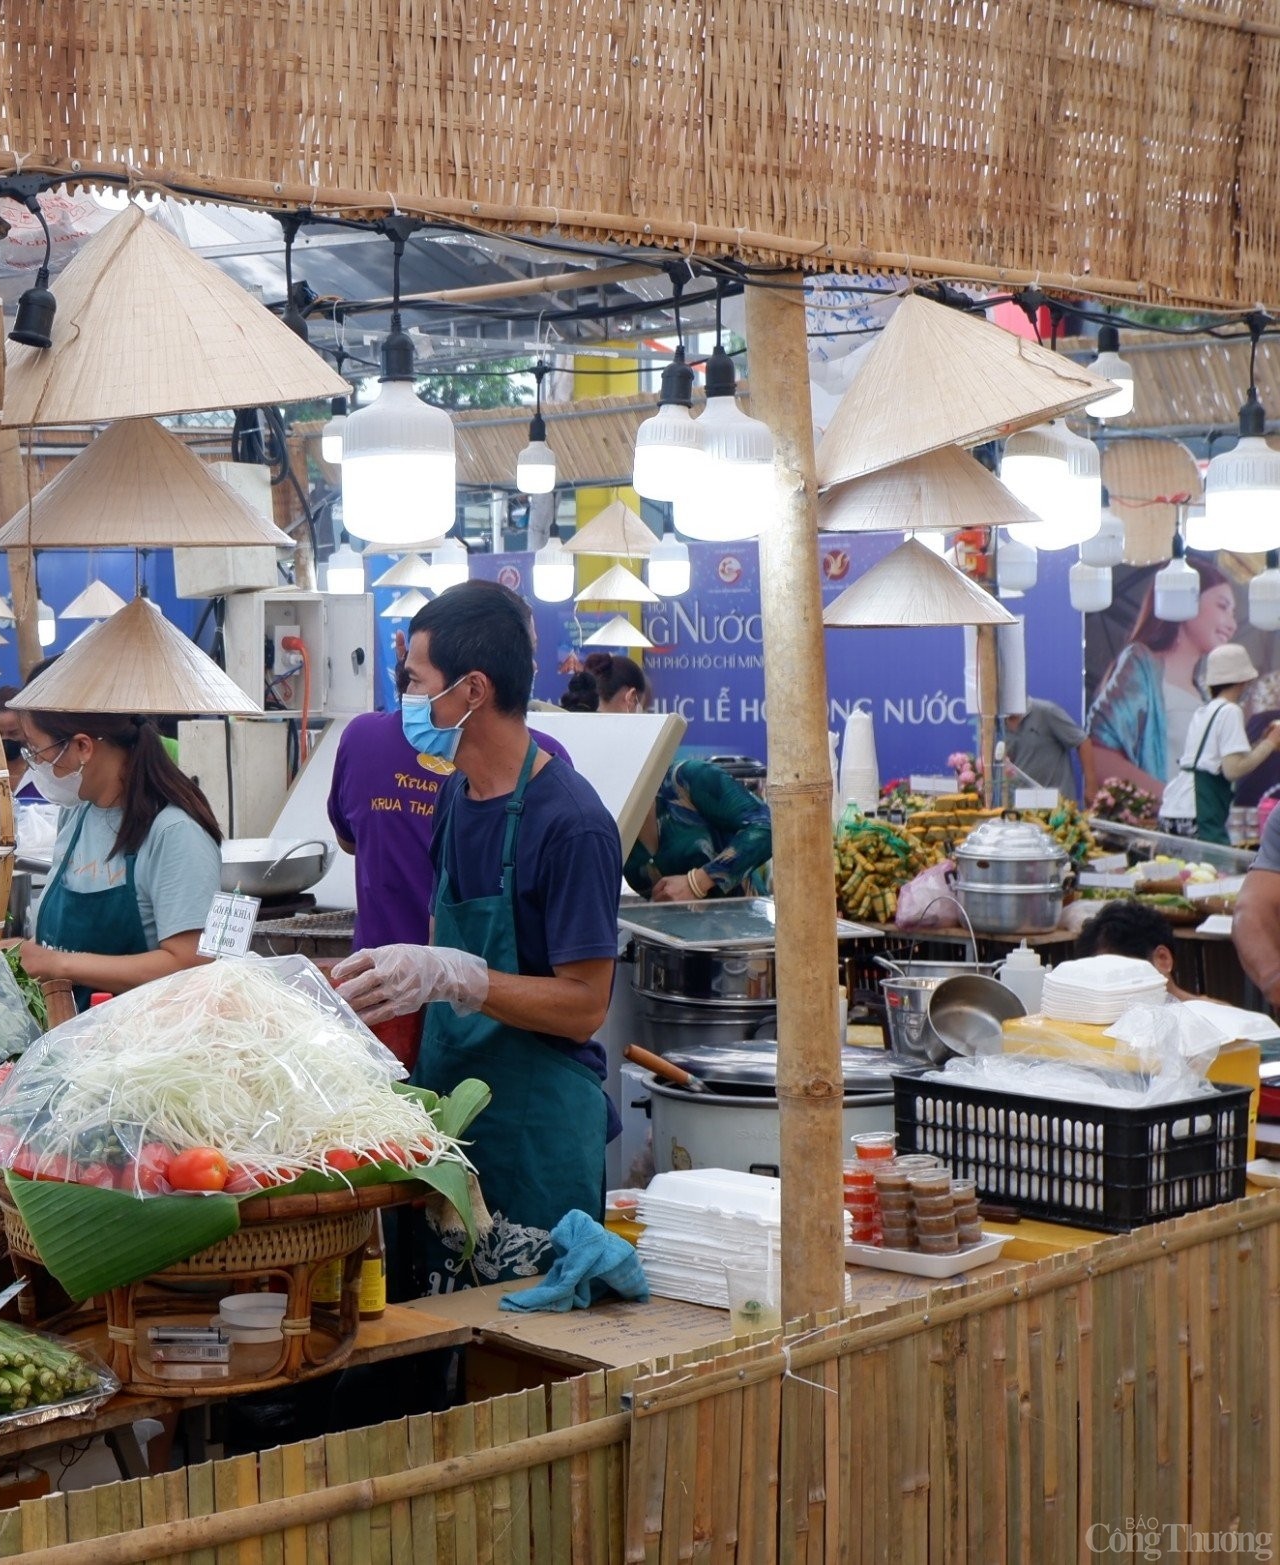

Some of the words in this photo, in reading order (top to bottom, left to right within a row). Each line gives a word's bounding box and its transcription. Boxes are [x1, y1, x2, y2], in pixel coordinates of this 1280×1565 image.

[738, 655, 765, 670] MIN
[703, 686, 731, 723] LỄ
[884, 690, 967, 725] NƯỚC
[370, 797, 402, 812] KRUA
